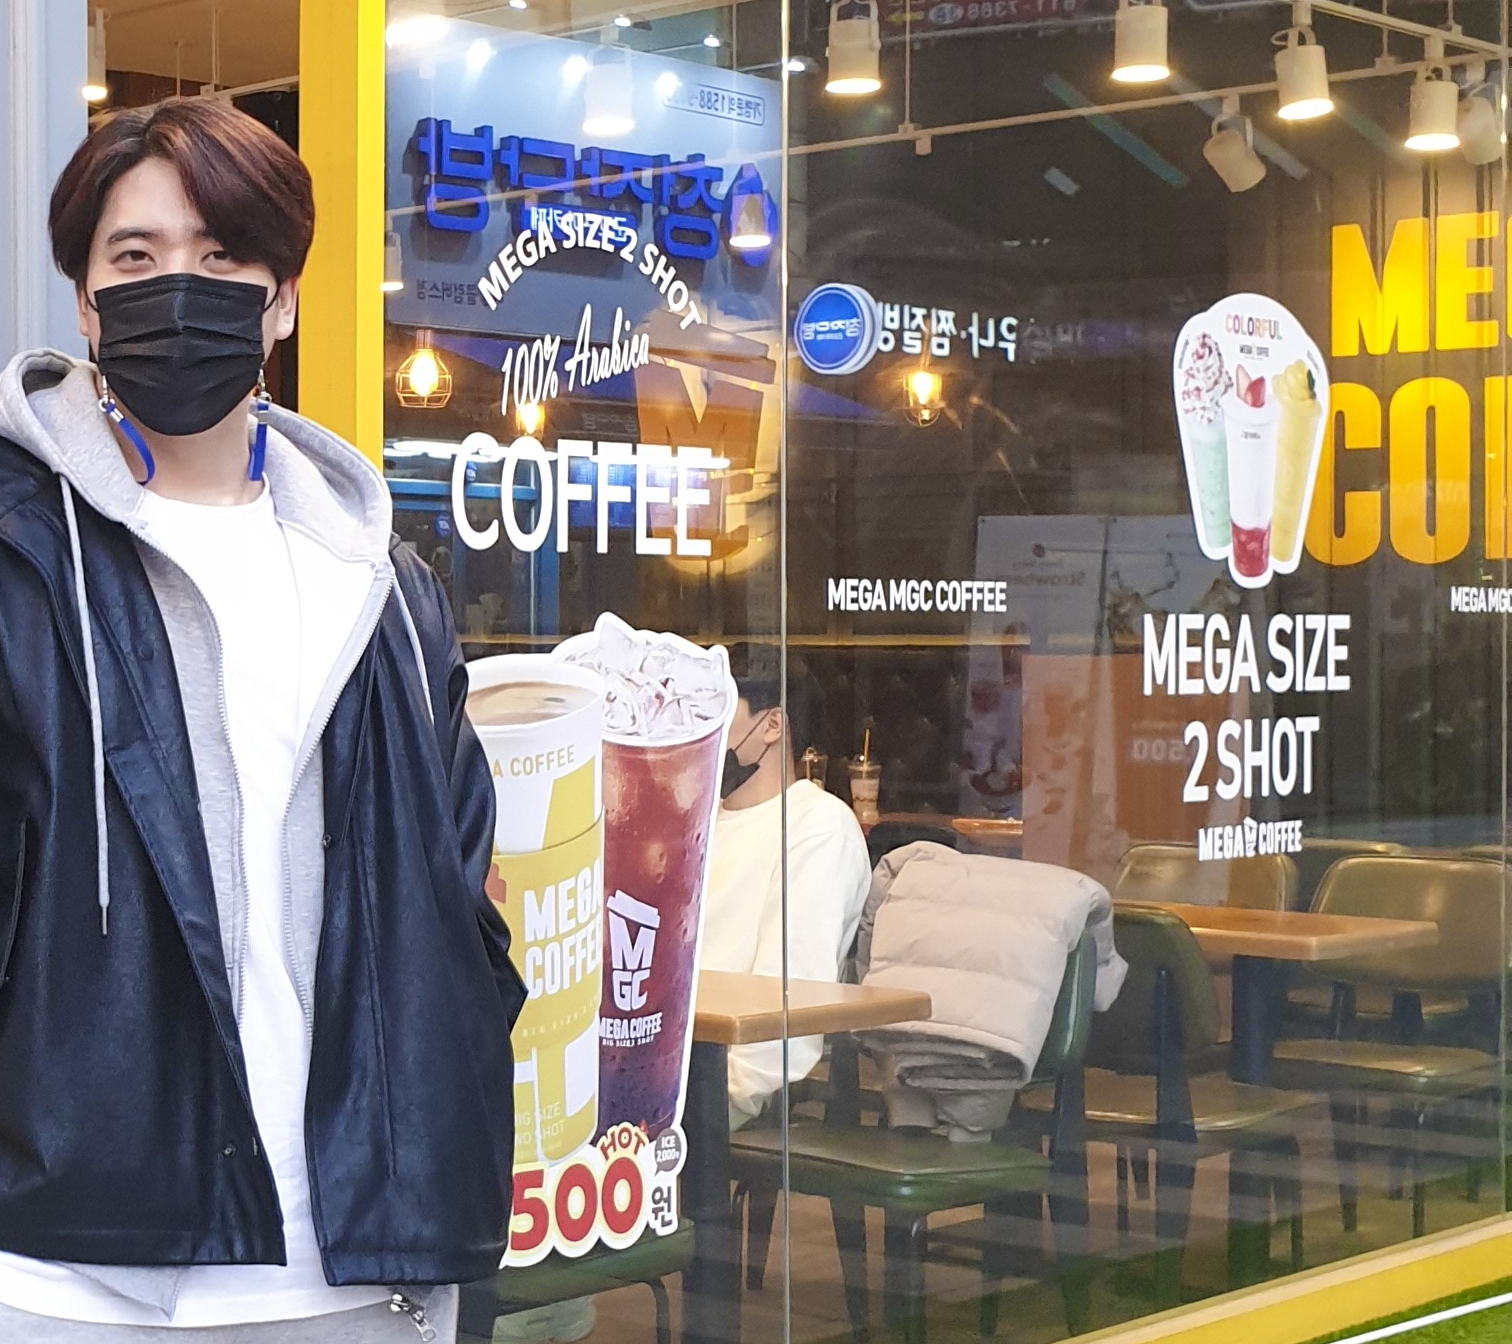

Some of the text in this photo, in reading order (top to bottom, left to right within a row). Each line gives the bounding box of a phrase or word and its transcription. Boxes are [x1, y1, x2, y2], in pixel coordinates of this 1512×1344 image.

[477, 221, 557, 310] MEGA
[562, 212, 616, 253] SIZE
[622, 232, 638, 263] 2
[639, 243, 702, 330] SHOT
[1331, 209, 1512, 357] ME
[1225, 314, 1283, 341] COLORFUL
[501, 303, 651, 416] 100% Arabica
[451, 431, 712, 557] COFFEE
[827, 577, 1008, 613] MEGA MGC COFFEE
[1450, 586, 1487, 613] MEGA
[1143, 613, 1351, 696] MEGA SIZE
[510, 744, 575, 777] COFFEE
[1182, 716, 1320, 803] 2 SHOT
[1198, 824, 1243, 861] MEGA
[1258, 820, 1302, 855] COFFEE
[599, 1012, 663, 1039] MEGA COFFEE
[600, 1127, 646, 1161] HOT
[661, 1135, 676, 1148] ICE
[651, 1186, 673, 1228] 원
